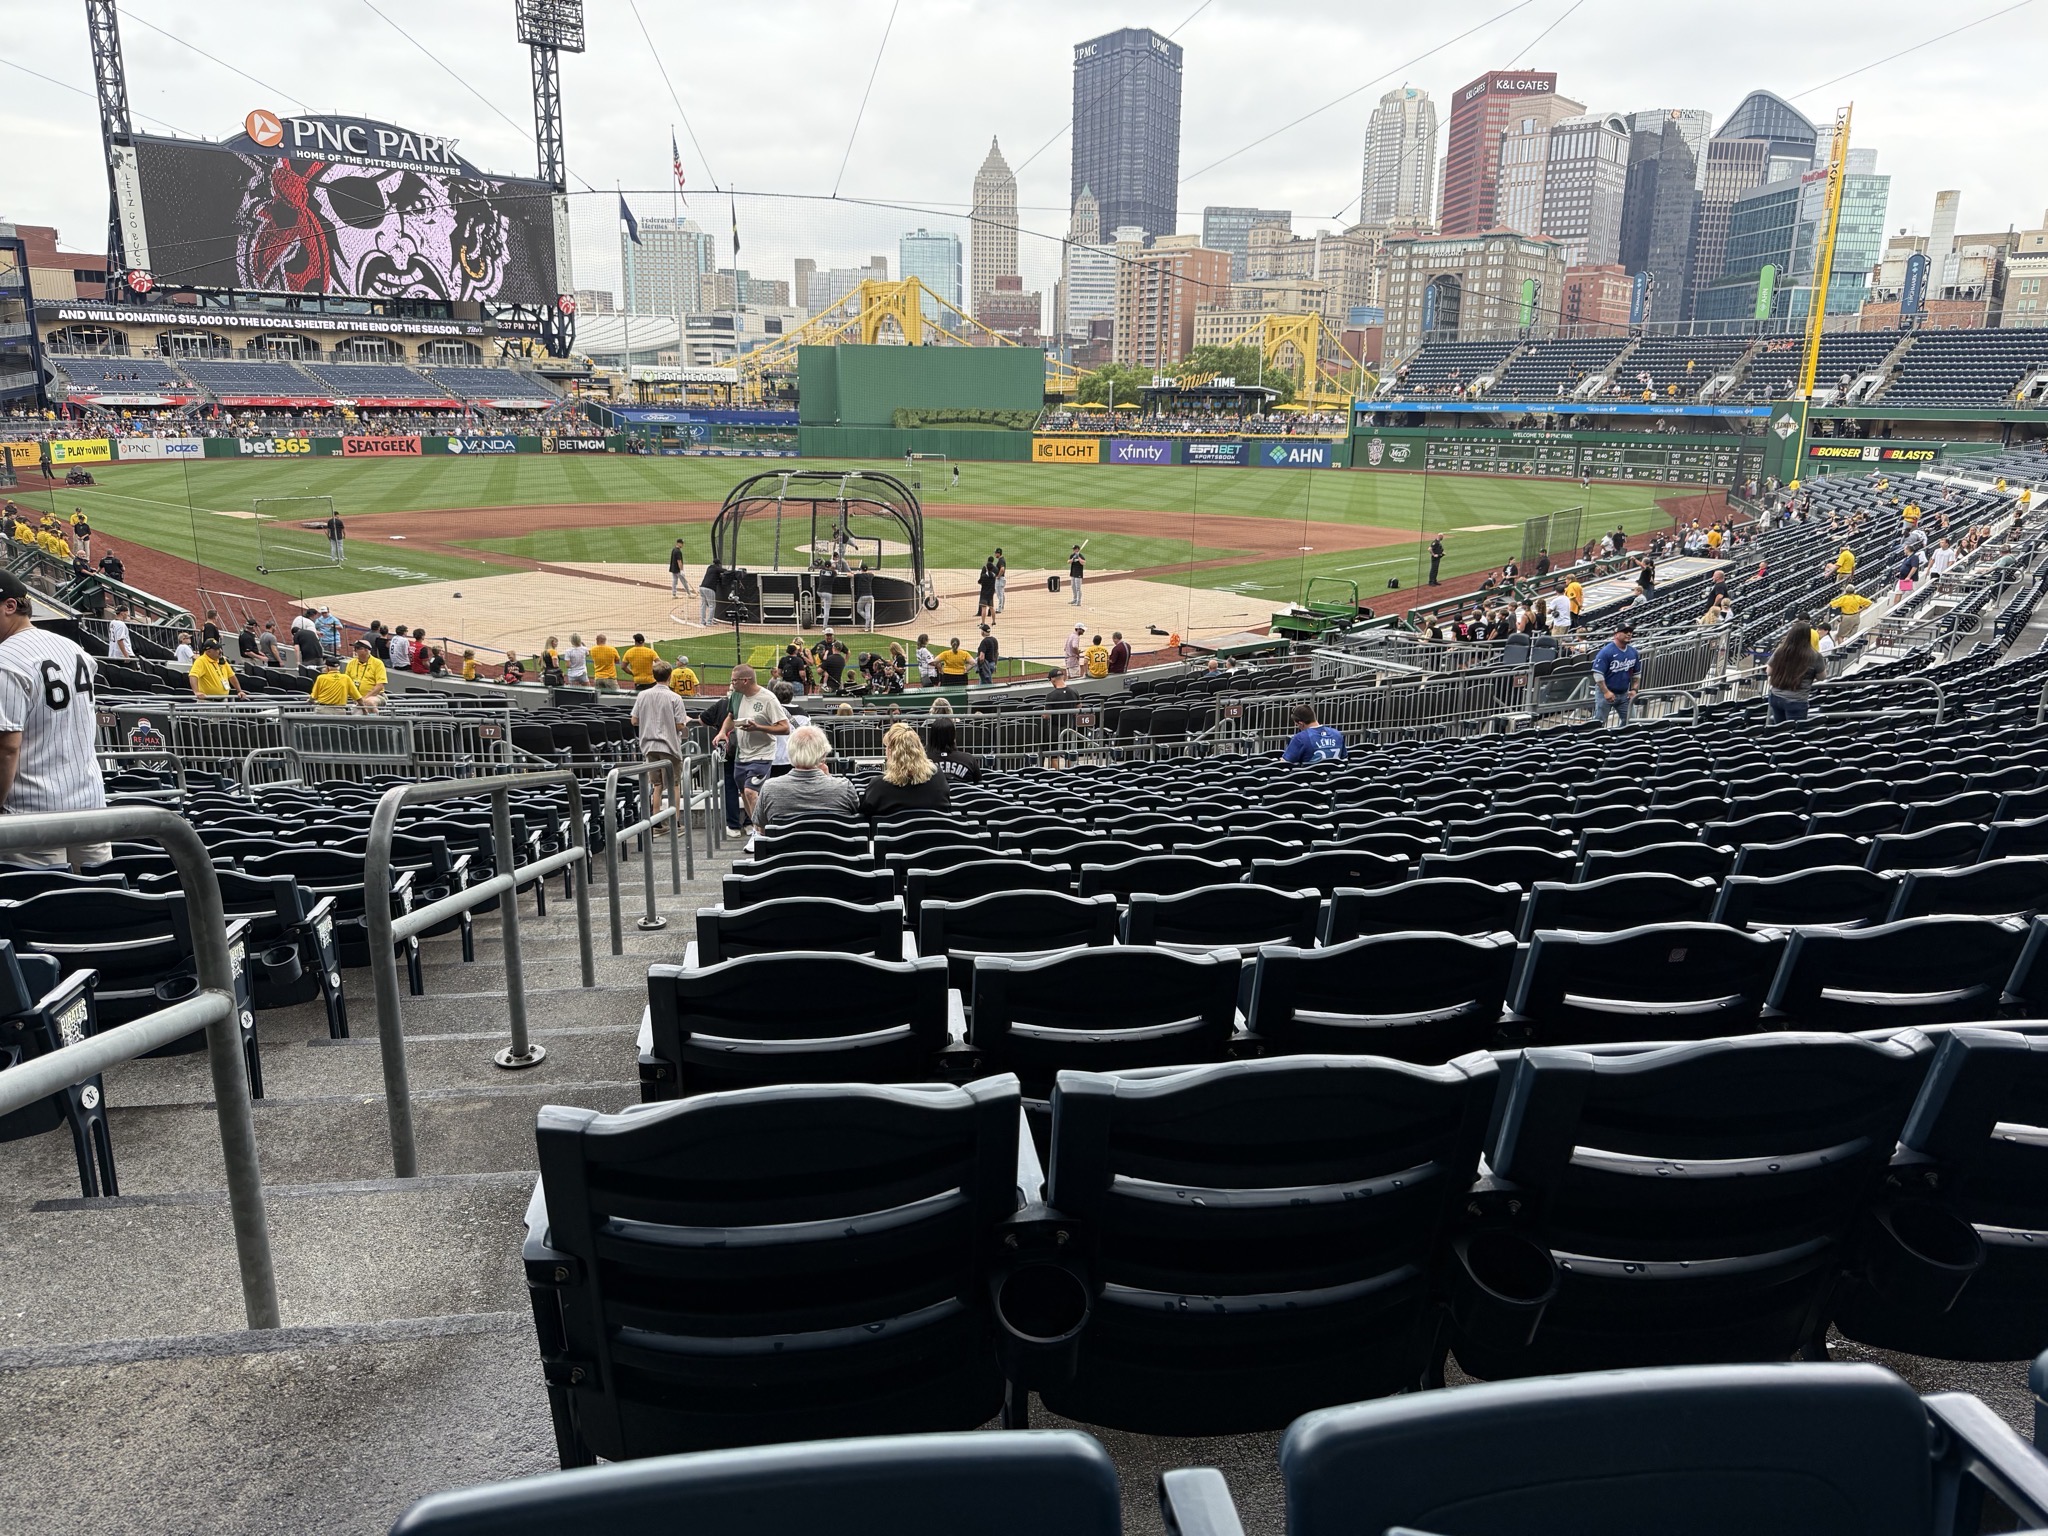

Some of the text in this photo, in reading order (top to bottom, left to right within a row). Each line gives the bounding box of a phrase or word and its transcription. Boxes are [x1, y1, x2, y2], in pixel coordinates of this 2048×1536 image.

[1074, 44, 1098, 60] UPMC
[1151, 36, 1170, 56] UPMC
[1496, 80, 1550, 91] K&L GATES
[288, 118, 462, 166] PNC PARK
[296, 150, 461, 176] HOME OF THE PITTSBURGH PIRATES
[132, 233, 142, 267] BUCS
[58, 309, 463, 335] AND WILL DONATING $15,000 TO THE LOCAL SHELTER AT THE END OF THE SEASON.
[513, 322, 525, 330] PM
[527, 323, 539, 331] 74°
[1159, 377, 1177, 388] IT'S
[1175, 370, 1222, 392] Miller
[1213, 377, 1236, 388] TIME
[67, 446, 85, 457] PLAY
[92, 445, 108, 456] WIN!
[128, 444, 152, 454] PNC
[165, 443, 199, 454] paze
[239, 438, 311, 454] bet365
[348, 439, 417, 454] SEATGEEK
[463, 440, 516, 450] VANDA
[558, 440, 606, 451] BETMGM
[1038, 444, 1094, 457] IC LIGHT
[1118, 444, 1164, 462] xfinity
[1288, 448, 1324, 463] AHN
[1817, 447, 1862, 458] BOWSER
[1891, 450, 1935, 461] BLASTS
[1475, 630, 1485, 640] 12
[1094, 653, 1106, 663] 22
[41, 654, 93, 710] 64
[677, 679, 692, 692] 30
[1315, 739, 1336, 749] LEWIS
